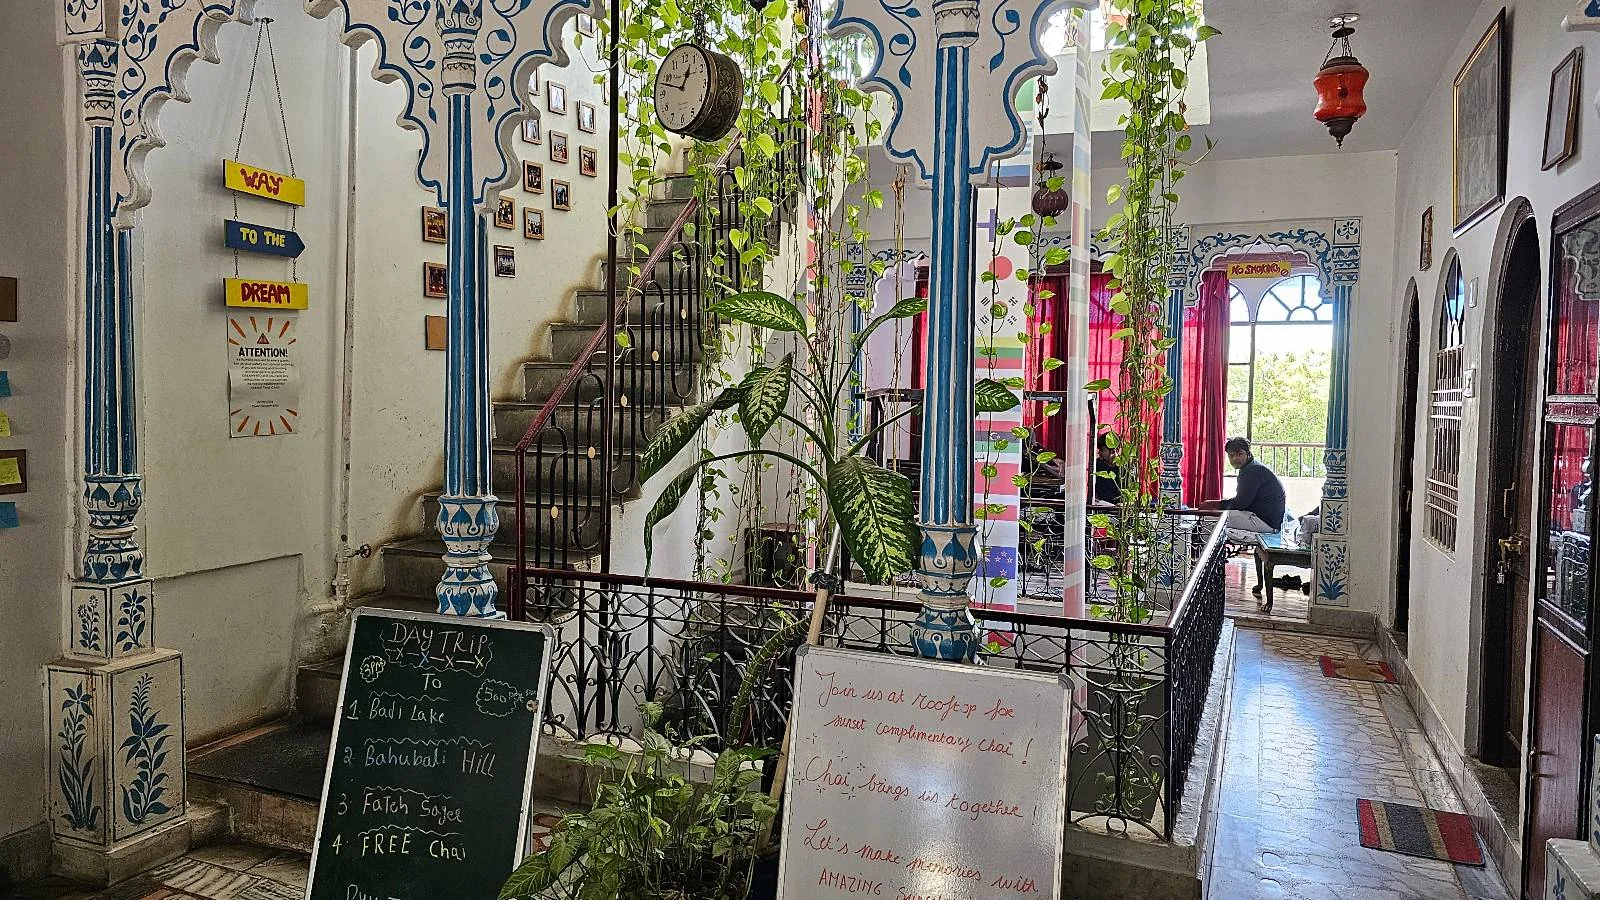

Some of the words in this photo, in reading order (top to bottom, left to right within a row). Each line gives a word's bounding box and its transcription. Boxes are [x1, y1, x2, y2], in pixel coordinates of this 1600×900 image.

[240, 168, 283, 196] WAY
[239, 227, 257, 245] TO
[264, 229, 286, 248] THE
[1231, 264, 1244, 275] NO
[241, 282, 291, 305] DREAM
[238, 346, 289, 357] ATTENTION!
[815, 669, 858, 708] Join
[861, 689, 883, 701] us
[888, 689, 904, 704] at
[368, 697, 403, 720] Badi
[410, 704, 445, 725] Lake
[824, 715, 866, 731] sunset
[364, 745, 447, 768] Bahubali
[858, 773, 909, 801] brings
[362, 833, 412, 857] FREE
[429, 840, 467, 861] Chai
[804, 818, 849, 854] Let's
[855, 844, 900, 864] make
[906, 857, 982, 881] memories
[991, 876, 1039, 893] with
